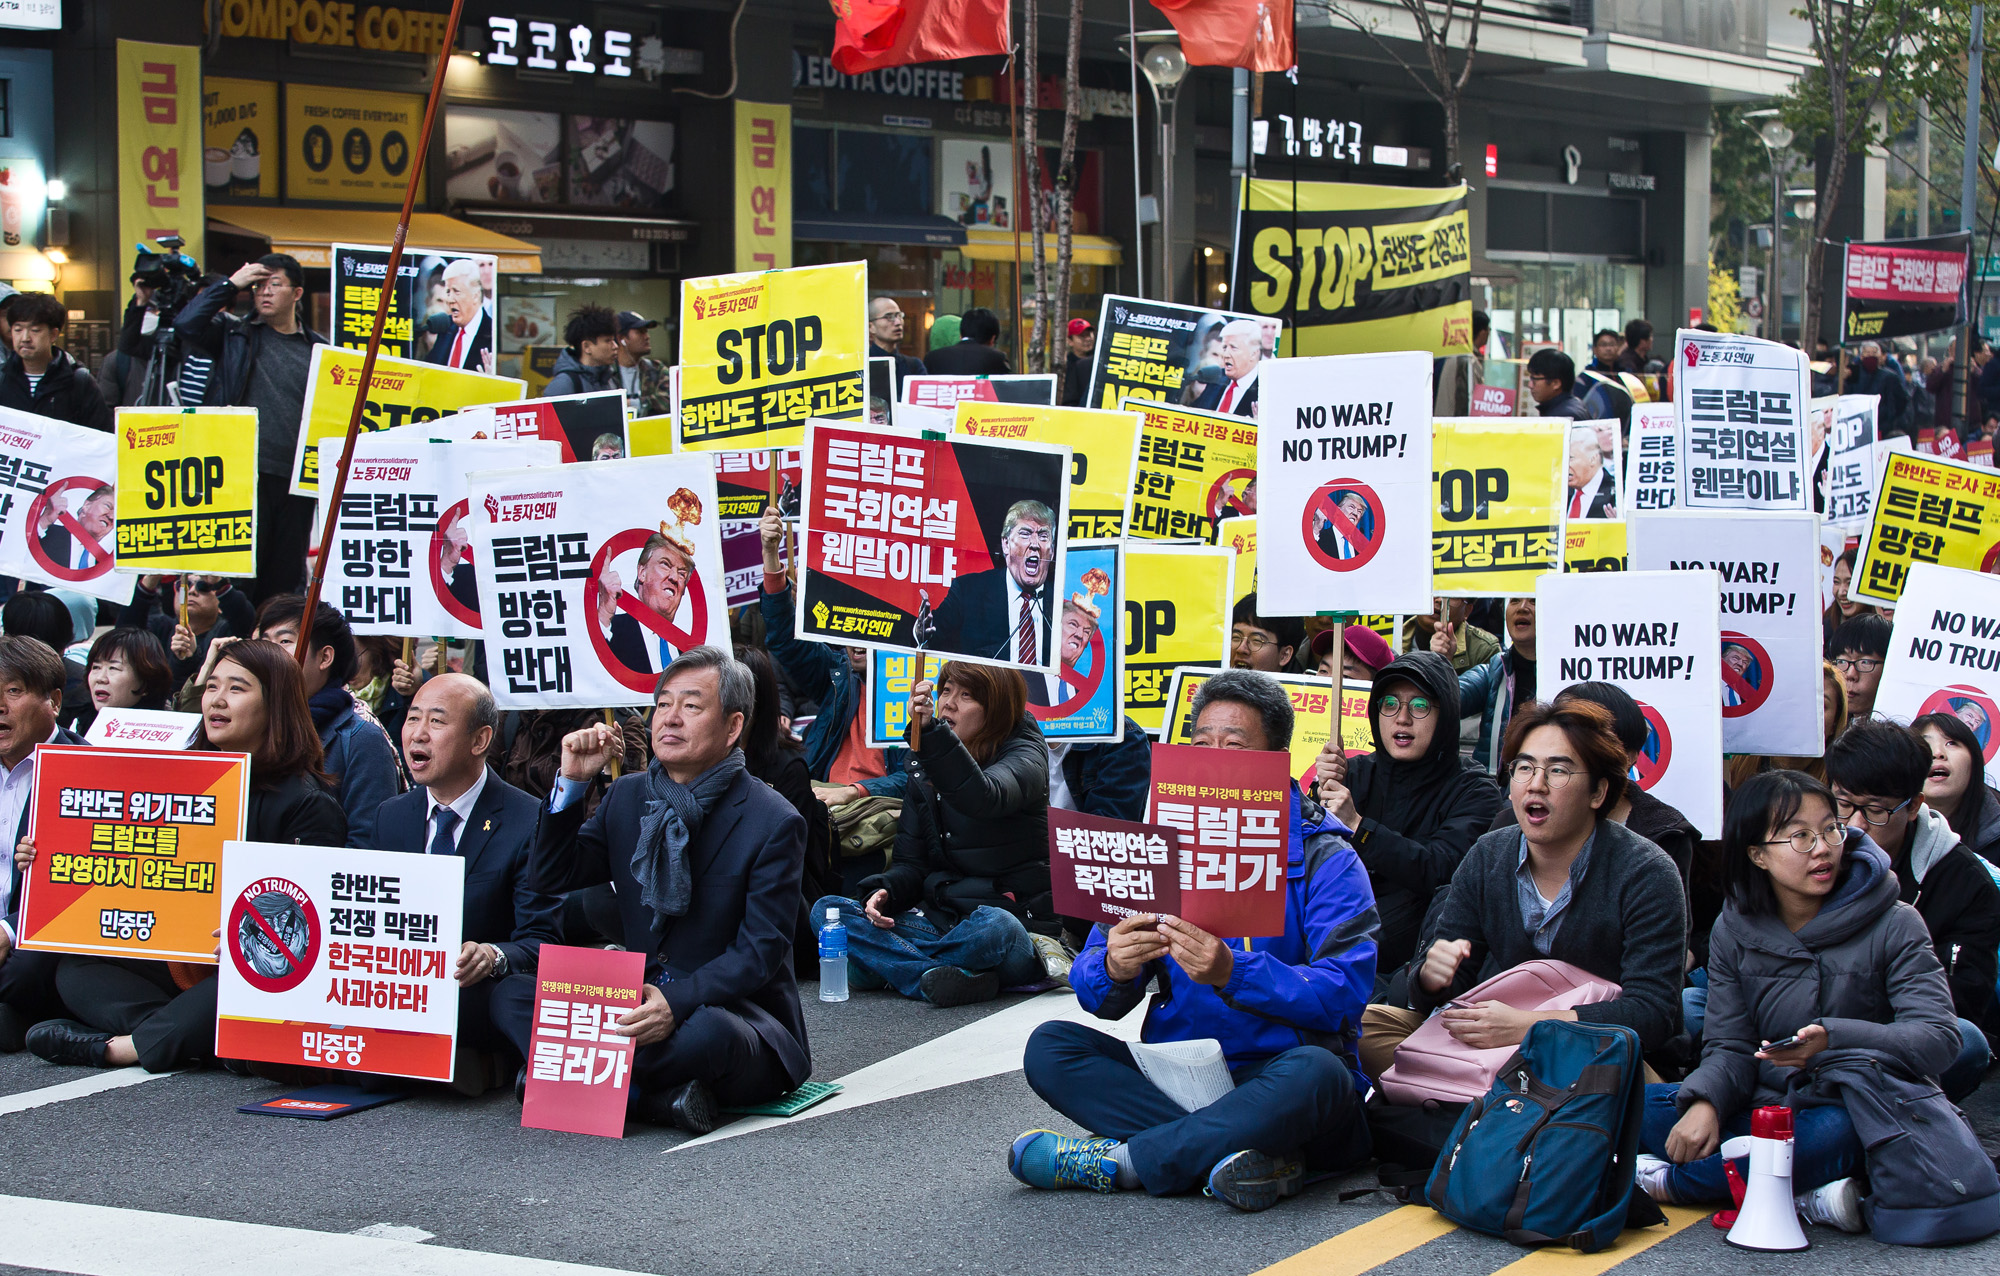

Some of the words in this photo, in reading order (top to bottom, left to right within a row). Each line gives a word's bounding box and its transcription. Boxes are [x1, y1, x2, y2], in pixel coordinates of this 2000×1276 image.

[487, 16, 632, 77] 코코호도
[880, 66, 963, 100] COFFEE
[304, 106, 330, 117] FRESH
[332, 108, 361, 121] COFFEE
[1278, 114, 1362, 165] 김밥천국
[945, 264, 995, 290] Kodak
[1251, 225, 1376, 314] STOP
[1848, 254, 1889, 290] 트럼프
[707, 295, 759, 317] 노동자연대
[716, 315, 822, 385] STOP
[1109, 332, 1170, 361] 트럼프
[1700, 350, 1755, 364] 노동자연대
[346, 375, 405, 391] 노자연대
[1106, 356, 1185, 389] 국회연설
[681, 396, 755, 438] 한반도
[761, 377, 863, 426] 긴장고조
[1474, 402, 1511, 415] TRUMP
[1483, 389, 1505, 403] NO
[1691, 389, 1793, 425] 트럼프
[979, 424, 1028, 437] 노동자연대
[1172, 416, 1200, 435] 군사
[1203, 422, 1229, 440] 긴장
[1231, 428, 1258, 447] 심화
[1296, 406, 1327, 429] NO
[1331, 402, 1393, 427] WAR!
[0, 433, 33, 450] 자연대
[137, 432, 176, 448] 노동자연대
[1282, 439, 1313, 462] NO
[1318, 434, 1407, 460] TRUMP!
[1640, 436, 1676, 458] 트럼
[1691, 428, 1797, 463] 국회연설
[1836, 417, 1863, 450] OP
[1939, 436, 1951, 450] NO
[0, 455, 53, 495] 럼프
[352, 466, 411, 482] 노동자연대
[353, 457, 419, 465] www.workerssolidarity.org
[826, 438, 925, 489] 트럼프
[1893, 461, 1942, 486] 한반도
[1945, 472, 1979, 494] 군사
[145, 456, 224, 510] STOP
[500, 490, 563, 502] www.workerssolidarity.org
[1432, 468, 1509, 522] OP
[1691, 467, 1800, 501] 웬말이냐
[340, 493, 440, 532] 트럼프
[501, 502, 557, 522] 노동자연대
[719, 501, 760, 516] 동자연대
[824, 485, 958, 541] 국회연설
[1884, 485, 1985, 536] 트럼프
[116, 522, 174, 554] 한반도
[176, 516, 253, 550] 긴장고조
[1432, 530, 1558, 570] 긴장고조
[1878, 524, 1946, 564] 방한
[341, 539, 413, 578] 방한
[491, 532, 593, 583] 트럼프
[822, 532, 957, 587] 웬말이냐
[1868, 559, 1910, 595] 반
[342, 586, 412, 625] 반대
[498, 589, 568, 638] 방한
[832, 605, 902, 621] www.workerssolidarity.org
[1719, 593, 1796, 616] RUMP!
[1931, 609, 1965, 634] NO
[829, 616, 894, 638] 노동자연대
[1125, 600, 1176, 655] OP
[1574, 624, 1606, 647] NO
[1612, 622, 1679, 646] WAR!
[1909, 637, 1942, 661] NO
[503, 646, 573, 694] 반대
[1560, 658, 1592, 681] NO
[1597, 655, 1694, 680] TRUMP!
[1291, 693, 1329, 714] 긴장
[115, 728, 173, 743] 노동자연대
[1044, 721, 1071, 730] 노동자연대
[60, 787, 124, 820] 한반도
[129, 792, 216, 825] 위기고조
[1156, 782, 1197, 798] 전쟁위협
[1198, 786, 1240, 801] 무기강매
[1242, 789, 1283, 803] 통상압력
[91, 823, 178, 857] 트럼프를
[1157, 802, 1280, 848] 트럼프
[1056, 827, 1169, 865] 북침전쟁연습
[50, 854, 136, 888] 환영하지
[141, 858, 215, 893] 않는다!
[331, 872, 400, 904] 한반도
[1074, 864, 1156, 901] 즉각중단!
[244, 883, 262, 903] NO
[262, 879, 309, 908] TRUMP!
[100, 909, 156, 940] 민중당
[329, 908, 376, 938] 전쟁
[383, 911, 438, 943] 막말!
[328, 942, 447, 979] 한국민에게
[326, 978, 428, 1013] 사과하라!
[541, 980, 571, 994] 전쟁위협
[573, 983, 604, 998] 무기강매
[605, 986, 637, 1001] 통상압력
[537, 998, 634, 1045] 트럼프
[302, 1031, 366, 1066] 민중당
[532, 1041, 628, 1089] 물러가
